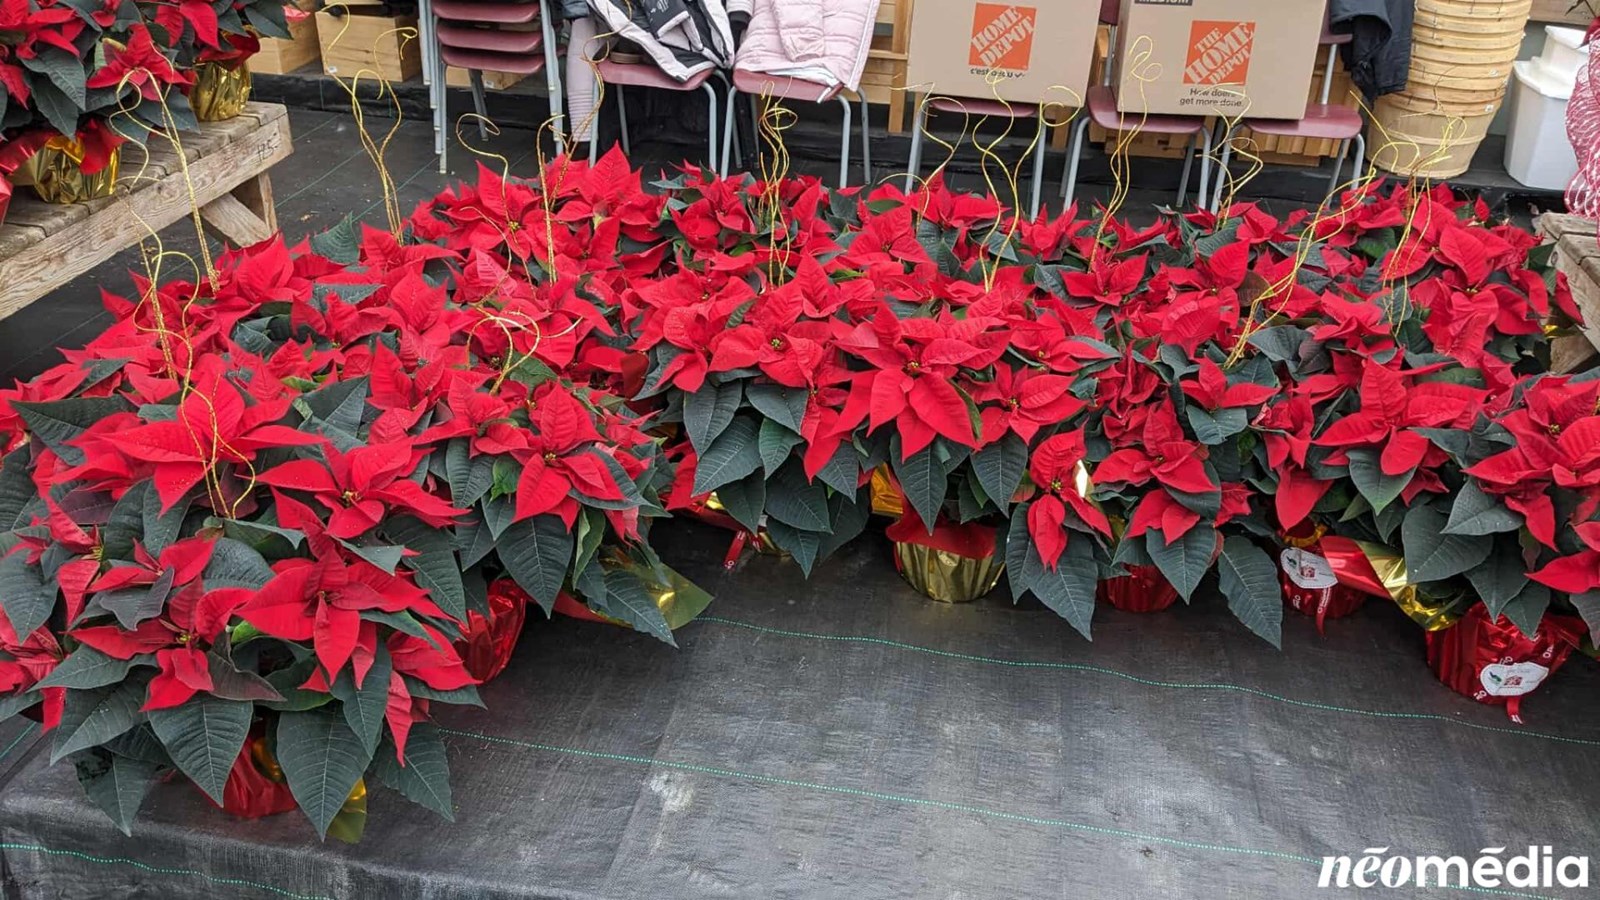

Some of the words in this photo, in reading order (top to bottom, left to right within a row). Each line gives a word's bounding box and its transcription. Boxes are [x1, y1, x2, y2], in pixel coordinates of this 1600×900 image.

[972, 6, 1022, 53] HOME
[979, 16, 1034, 67] DEPOT
[1194, 27, 1222, 53] THE
[1185, 22, 1254, 83] HOME
[1208, 46, 1250, 85] DEPOT
[1180, 98, 1194, 106] get
